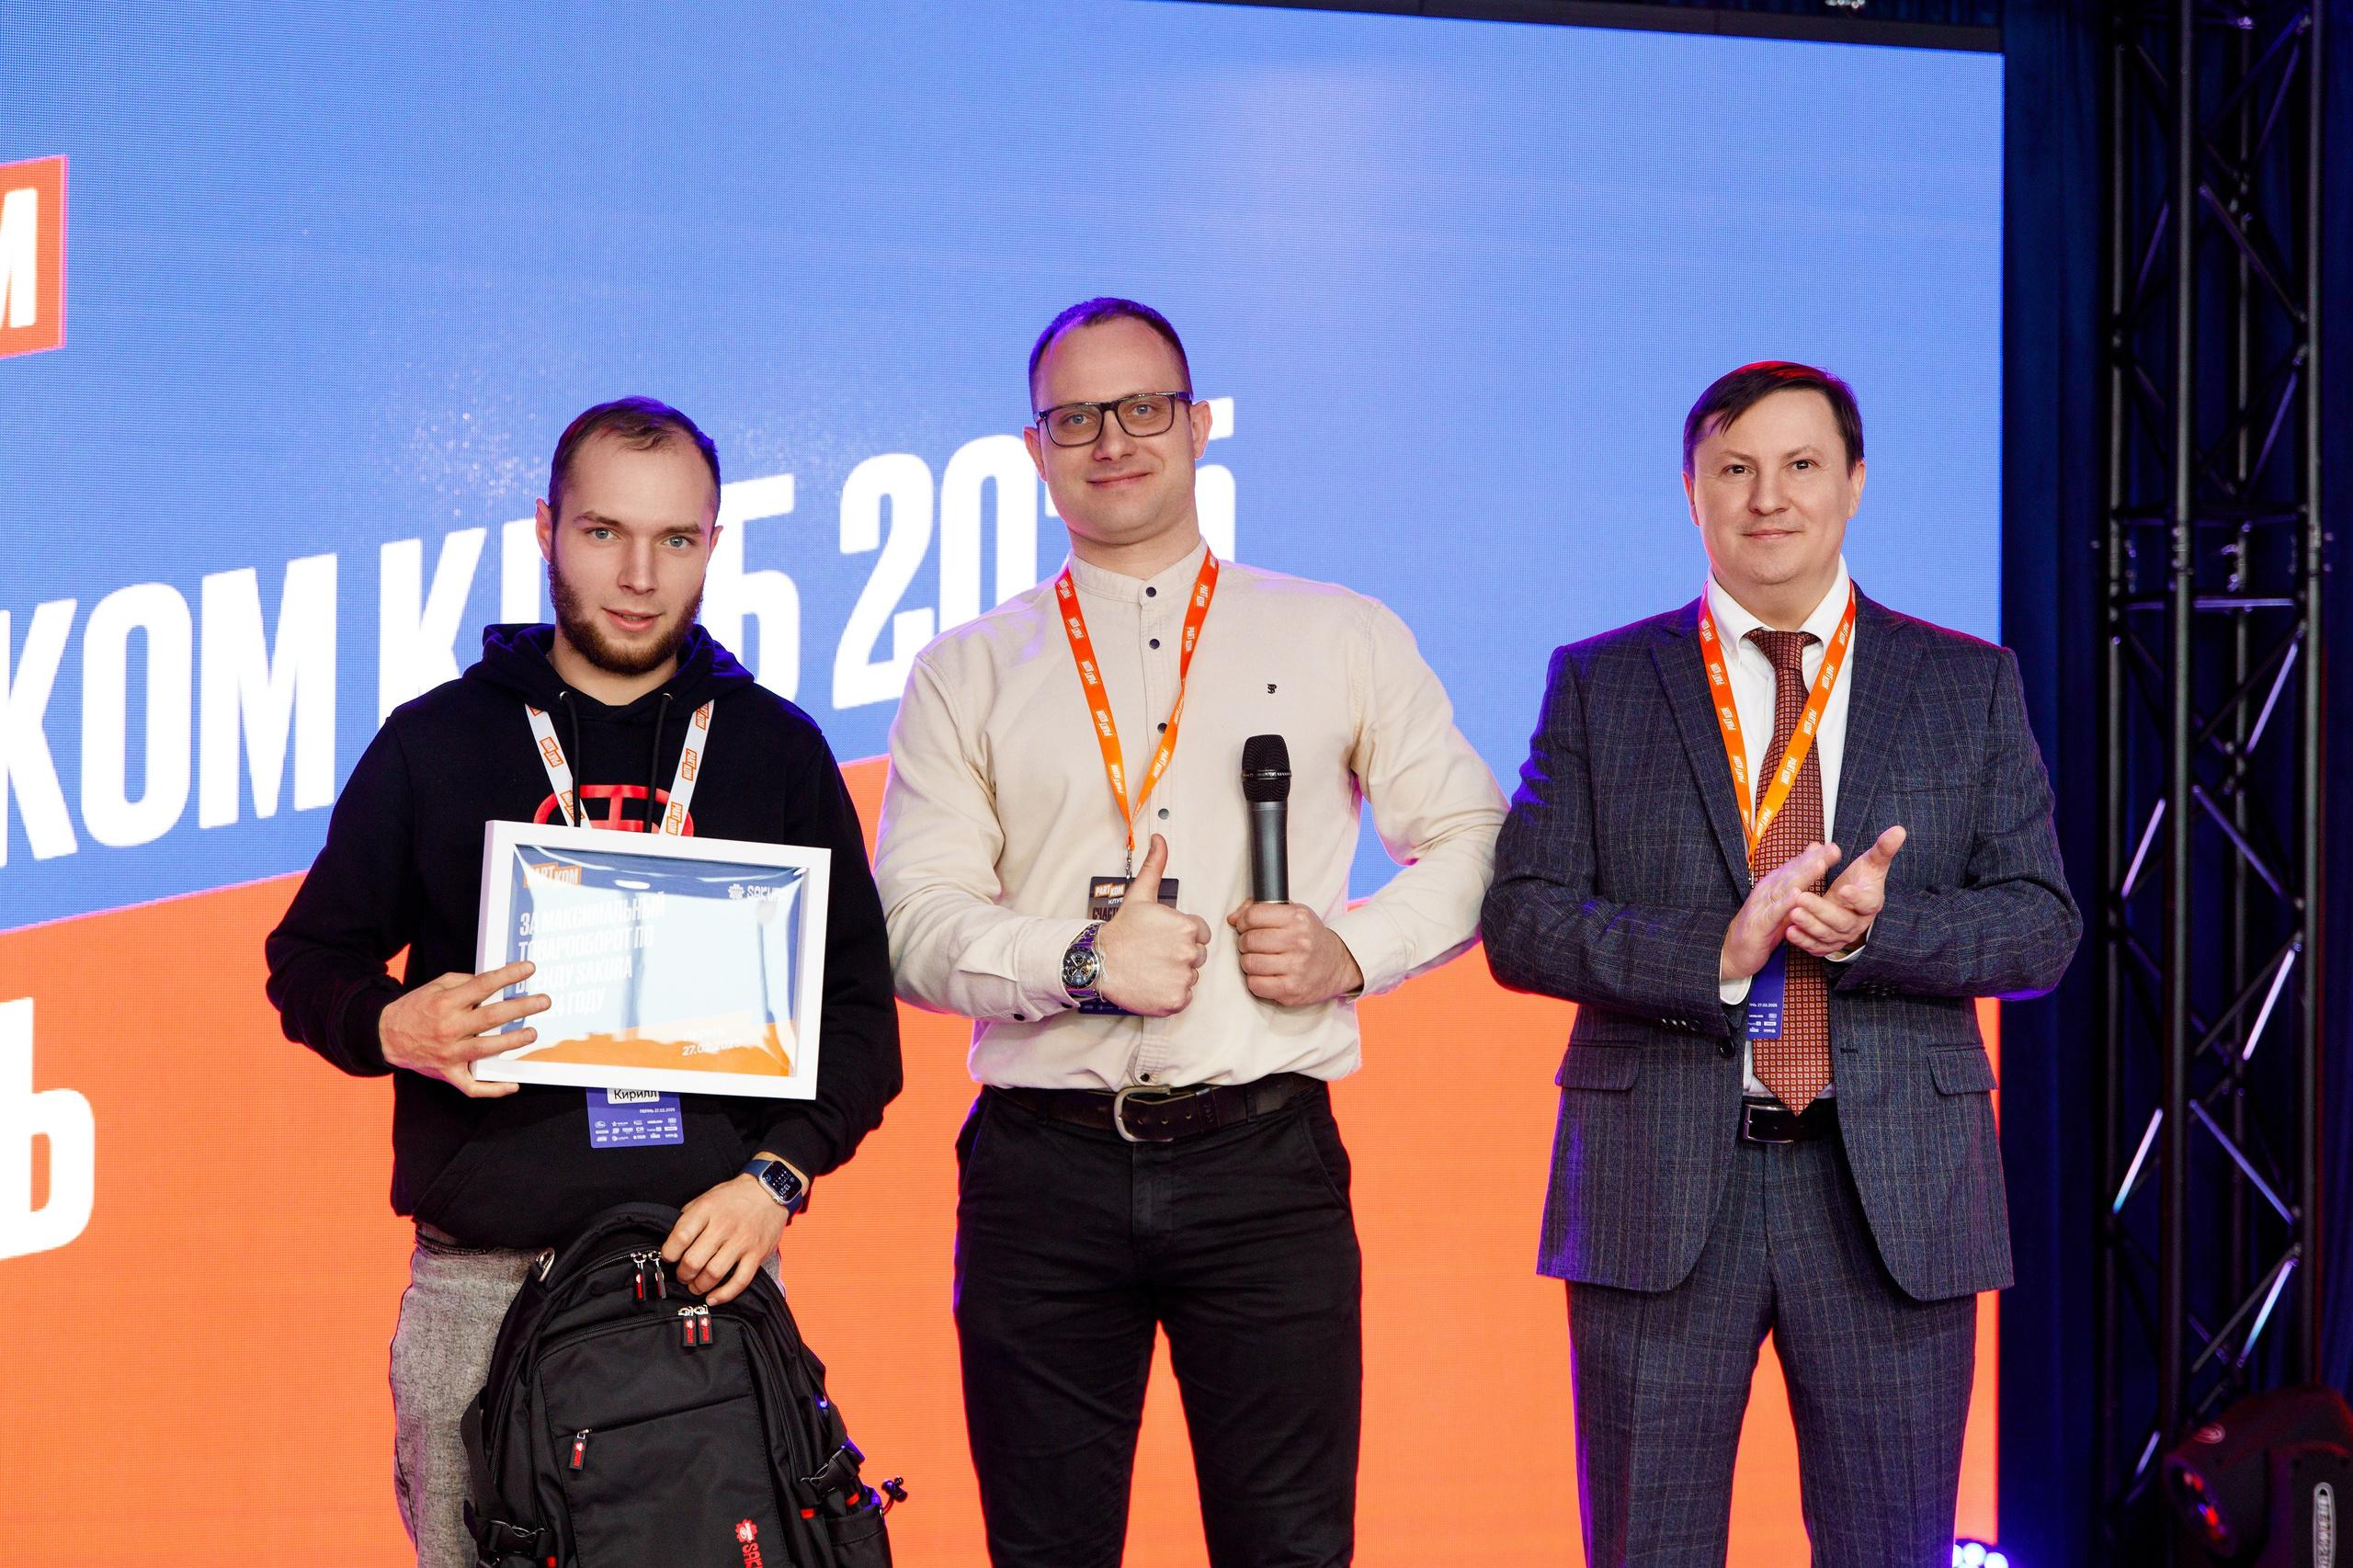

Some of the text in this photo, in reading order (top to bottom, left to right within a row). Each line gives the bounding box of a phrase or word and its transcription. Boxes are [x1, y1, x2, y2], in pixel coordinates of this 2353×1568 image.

[379, 473, 801, 728] КБ
[1808, 708, 1817, 725] PART
[688, 750, 697, 768] PART
[1153, 748, 1169, 778] PART KOM
[1780, 756, 1797, 785] PART KOM
[672, 802, 682, 822] PART
[1764, 807, 1772, 825] PART
[555, 869, 578, 886] KOM
[1096, 884, 1124, 897] PART KOM
[520, 892, 666, 936] ЗА МАКСИМАЛЬНЫЙ
[517, 924, 655, 963] ТОВАРООБОРОТ ПО
[575, 956, 632, 985] SAKURA
[567, 987, 607, 1016] ГОДУ
[683, 1028, 724, 1041] ПЕРМЬ
[683, 1039, 741, 1055] 27.02.2025
[614, 1088, 657, 1101] Кирилл
[742, 1542, 763, 1568] SAK
